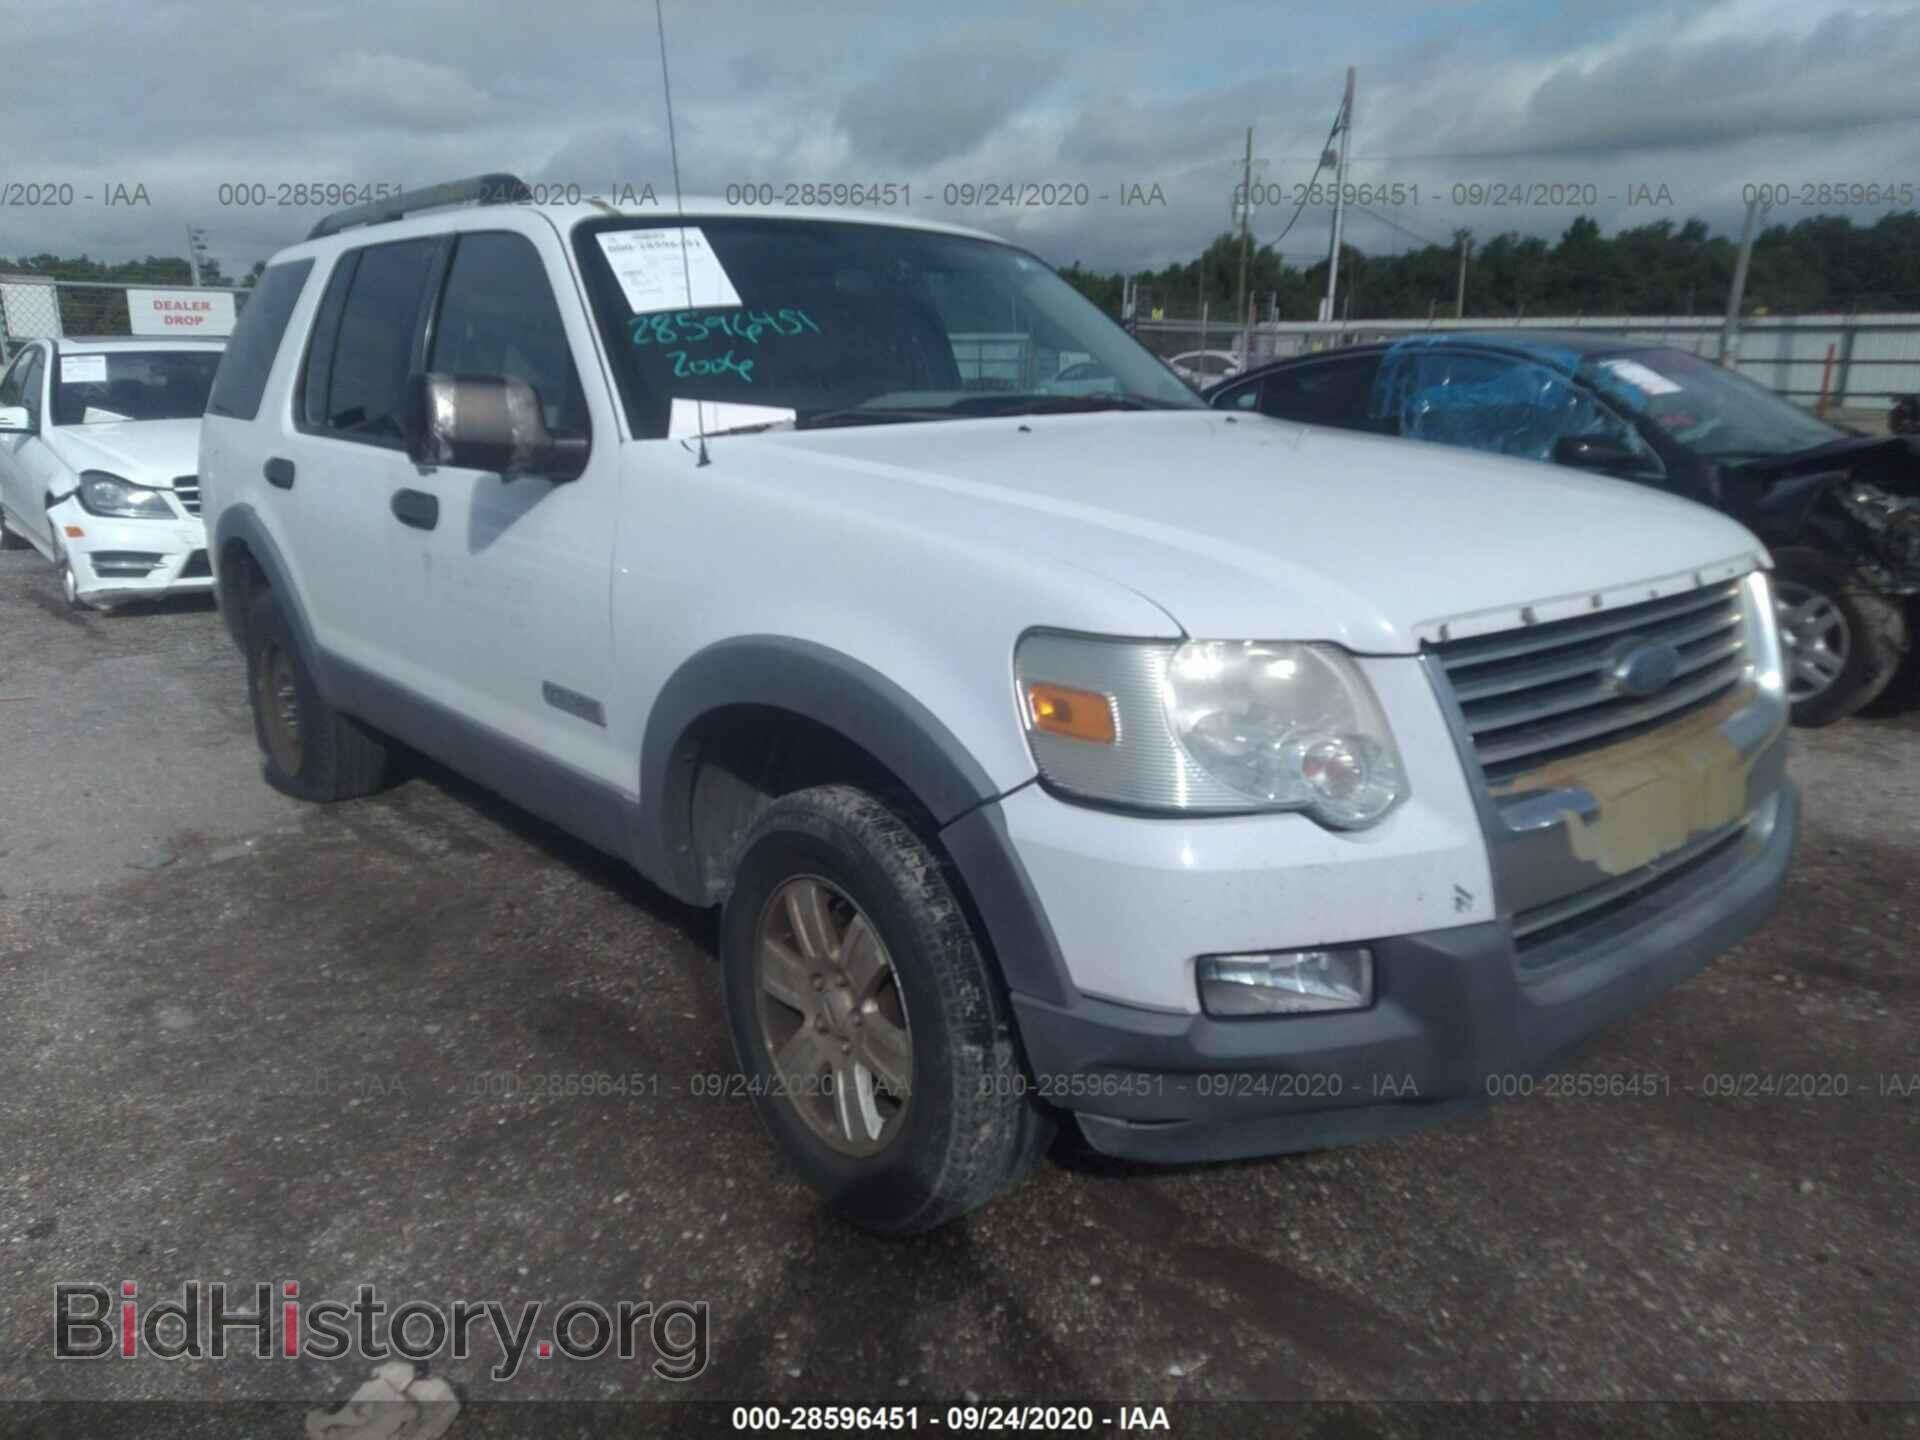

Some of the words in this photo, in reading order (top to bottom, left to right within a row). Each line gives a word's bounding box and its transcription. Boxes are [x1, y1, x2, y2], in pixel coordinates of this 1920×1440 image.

[153, 300, 211, 311] DEALER
[164, 315, 204, 325] DROP
[629, 309, 821, 344] 28596451
[667, 350, 753, 382] 2006
